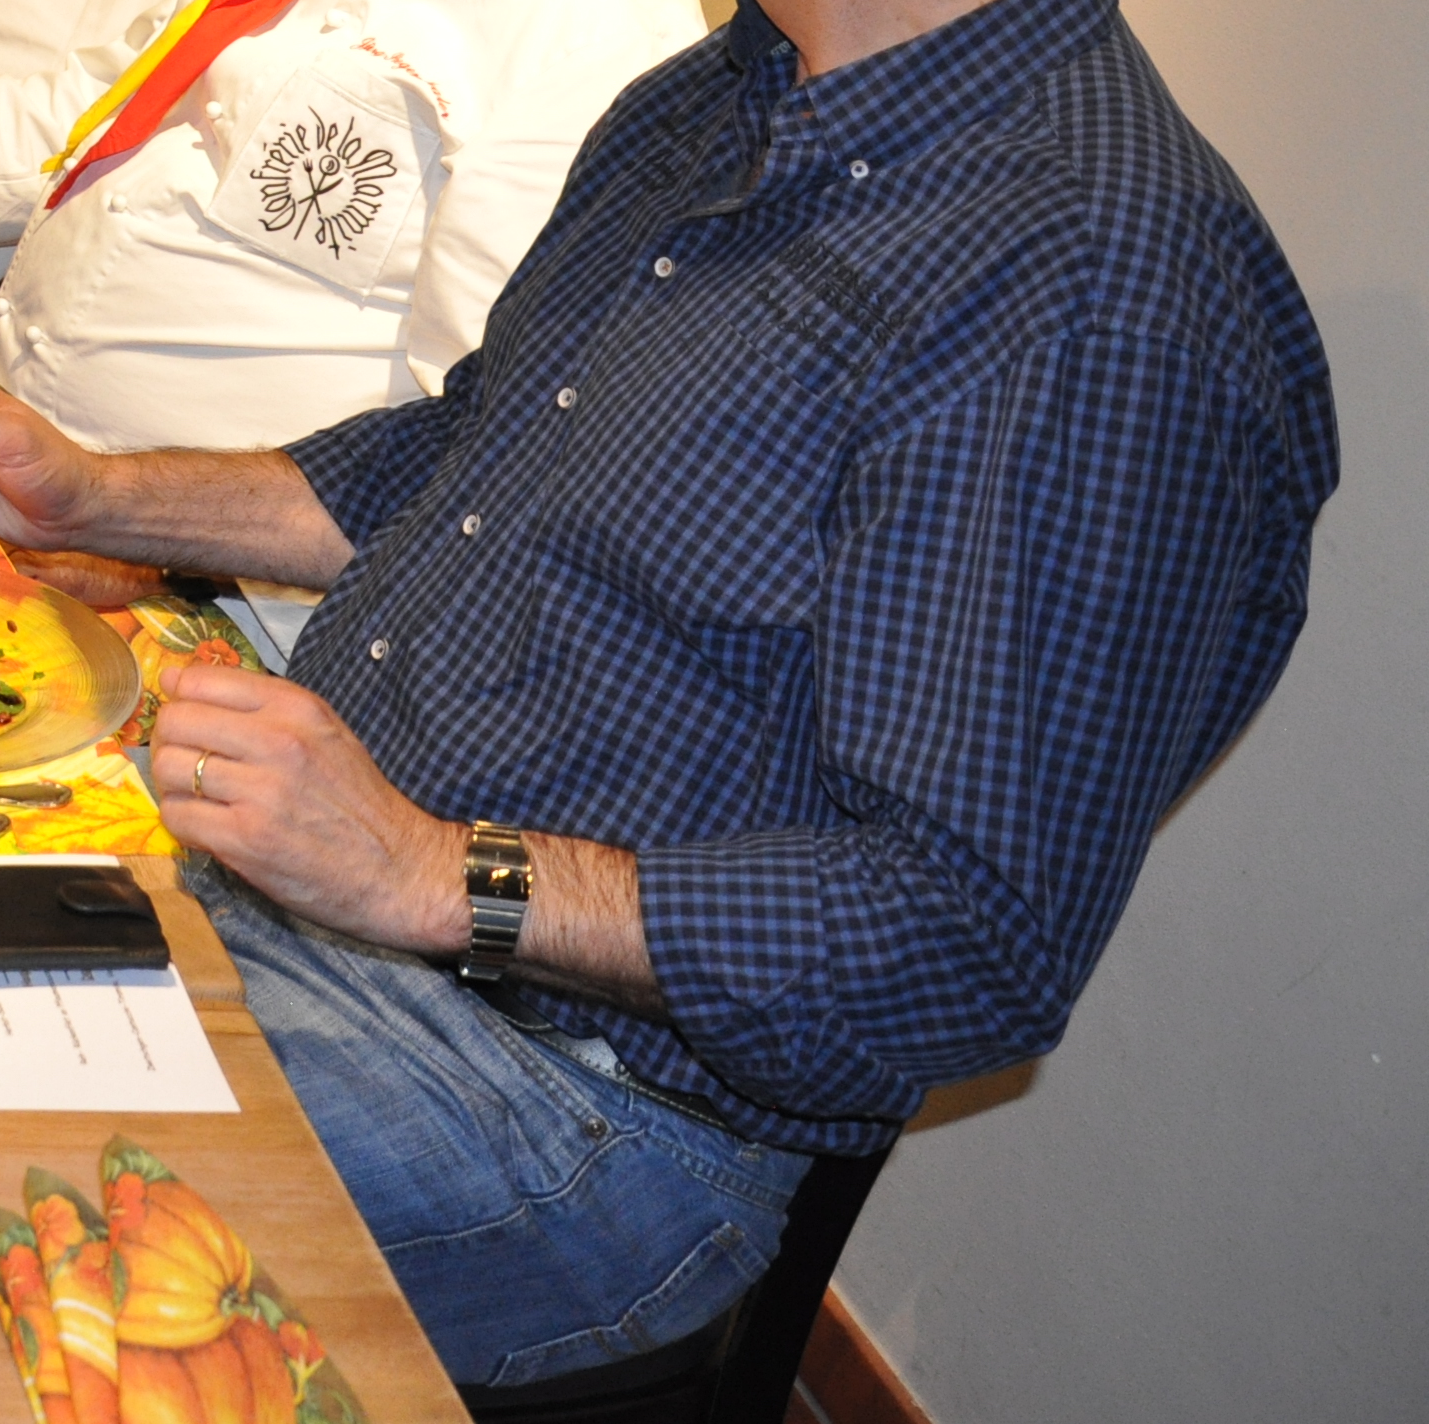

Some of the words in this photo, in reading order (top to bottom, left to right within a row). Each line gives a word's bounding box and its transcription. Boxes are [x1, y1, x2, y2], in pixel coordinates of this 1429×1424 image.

[308, 105, 339, 152] de
[337, 116, 361, 165] la
[250, 123, 311, 231] Confrérie
[314, 149, 397, 260] Marmite
